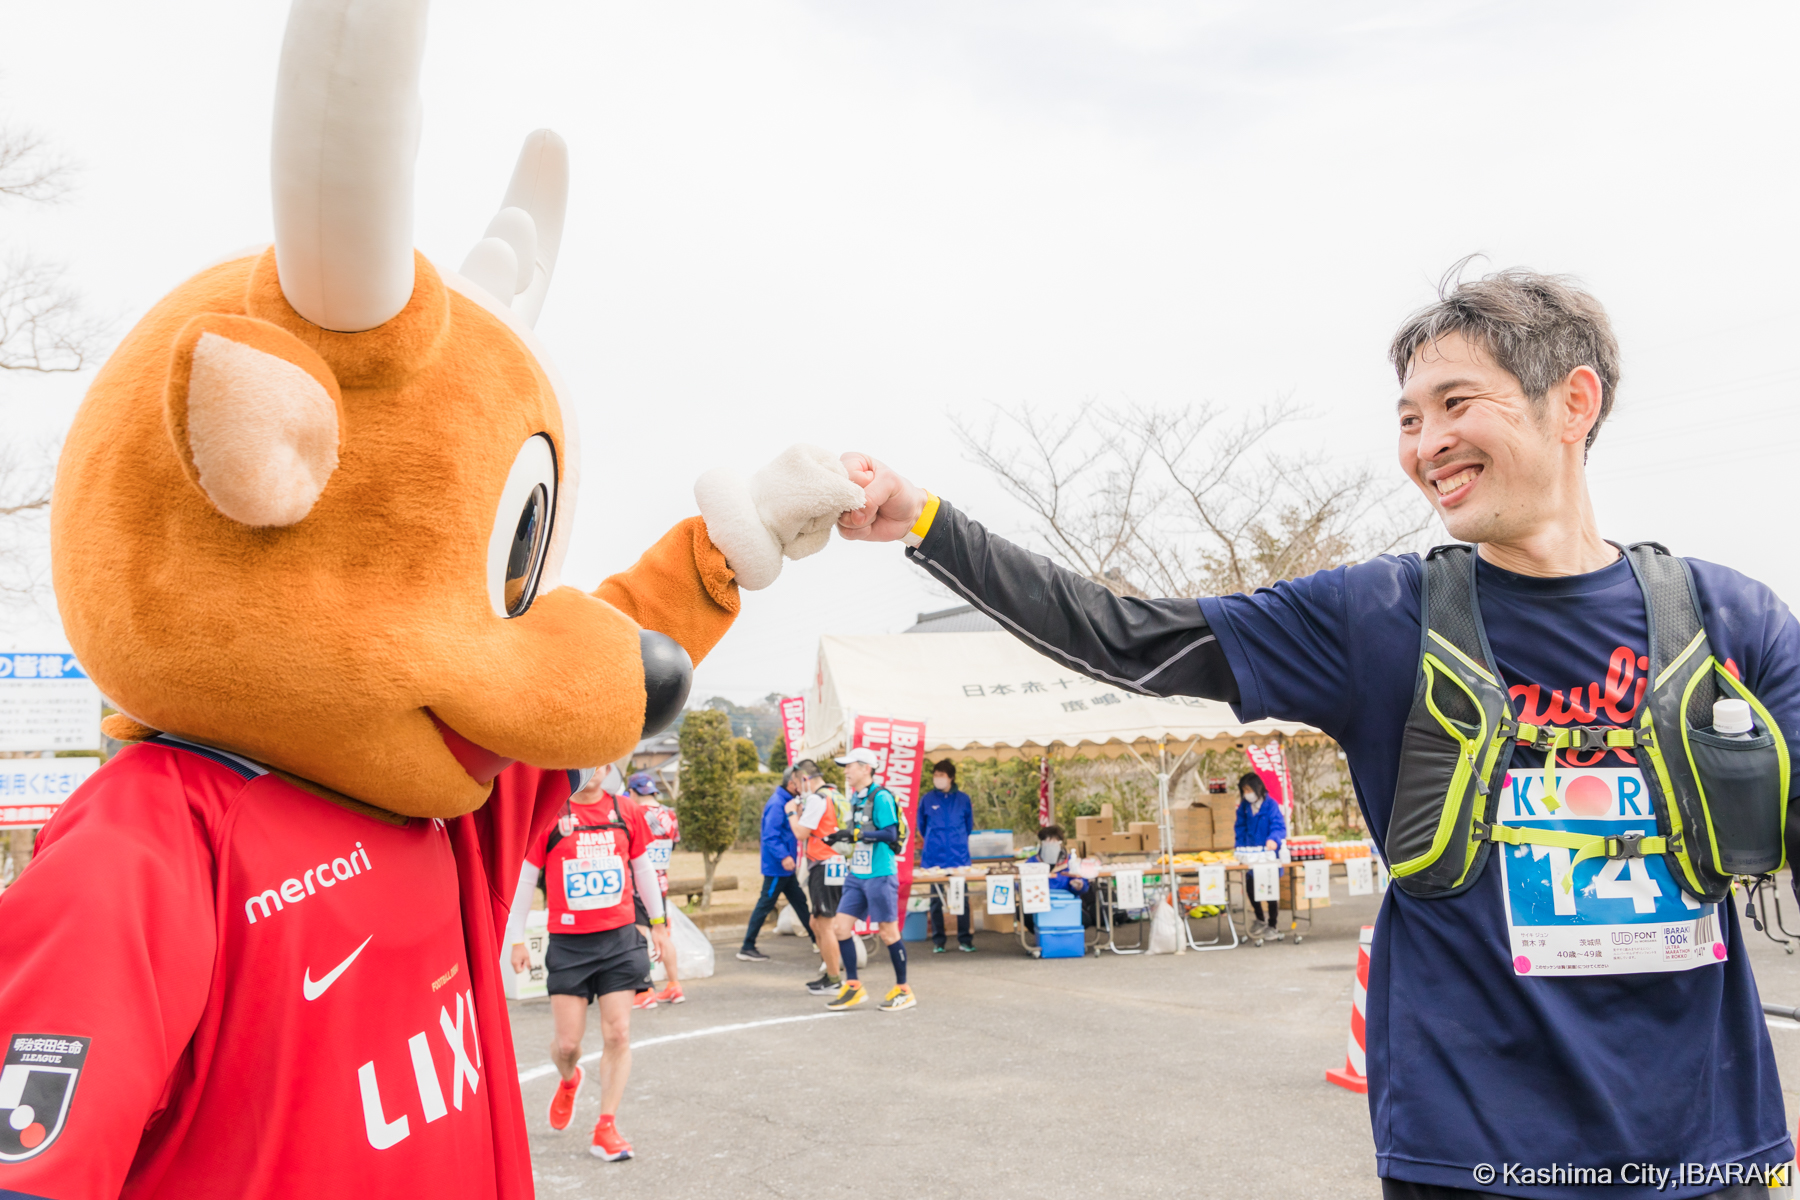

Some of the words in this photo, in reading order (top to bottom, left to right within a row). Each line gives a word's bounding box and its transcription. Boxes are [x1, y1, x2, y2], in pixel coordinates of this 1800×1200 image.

[1060, 691, 1208, 712] 鹿嶋区
[885, 724, 919, 808] IBARAKI
[1512, 775, 1657, 816] KOR
[576, 831, 615, 846] JAPAN
[576, 844, 616, 859] RUGBY
[829, 863, 849, 877] 11
[1530, 830, 1701, 915] 14
[245, 841, 372, 924] mercari
[569, 870, 621, 898] 303
[1611, 931, 1633, 945] UD
[1634, 931, 1657, 939] FONT
[1663, 926, 1691, 935] IBARAKI
[1579, 938, 1602, 947] 茨城県
[1664, 934, 1688, 945] 100k
[13, 1038, 84, 1055] 明治安田生命
